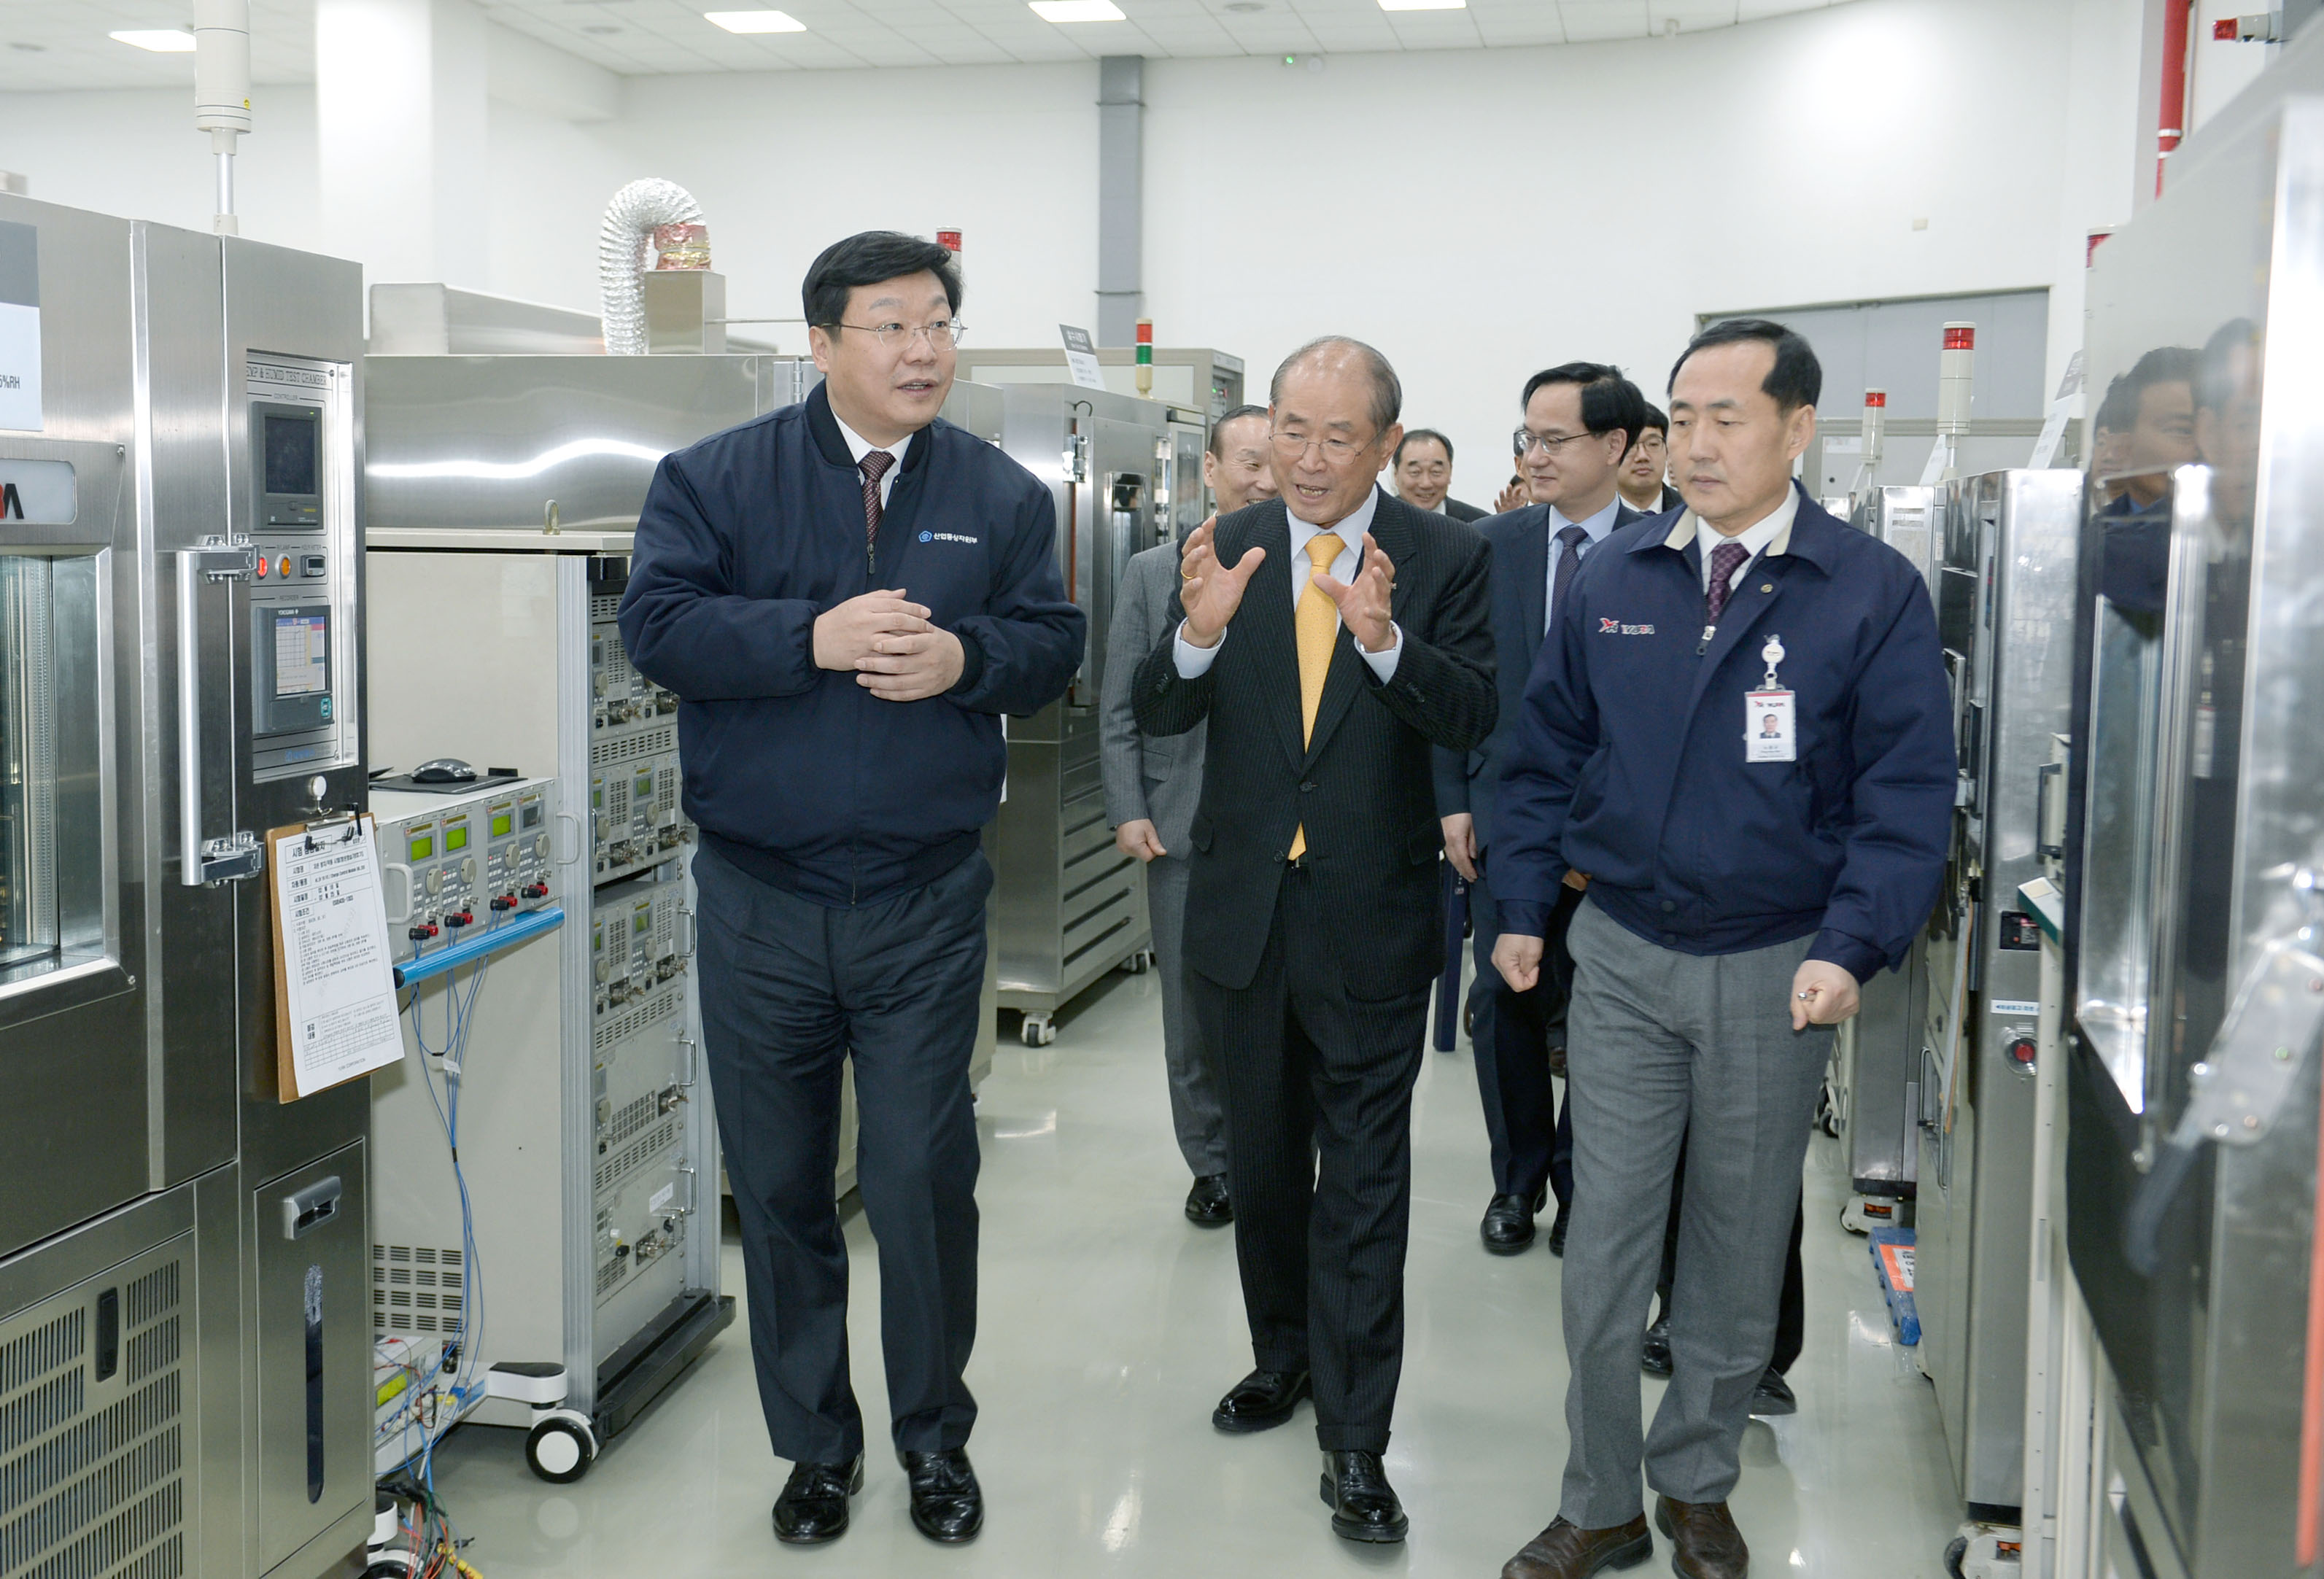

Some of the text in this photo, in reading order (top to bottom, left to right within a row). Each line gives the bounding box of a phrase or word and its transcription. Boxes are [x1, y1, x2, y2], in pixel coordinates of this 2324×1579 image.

[285, 370, 301, 383] TEST
[301, 373, 327, 385] CHAMBER
[934, 532, 977, 543] 산업통상자원부
